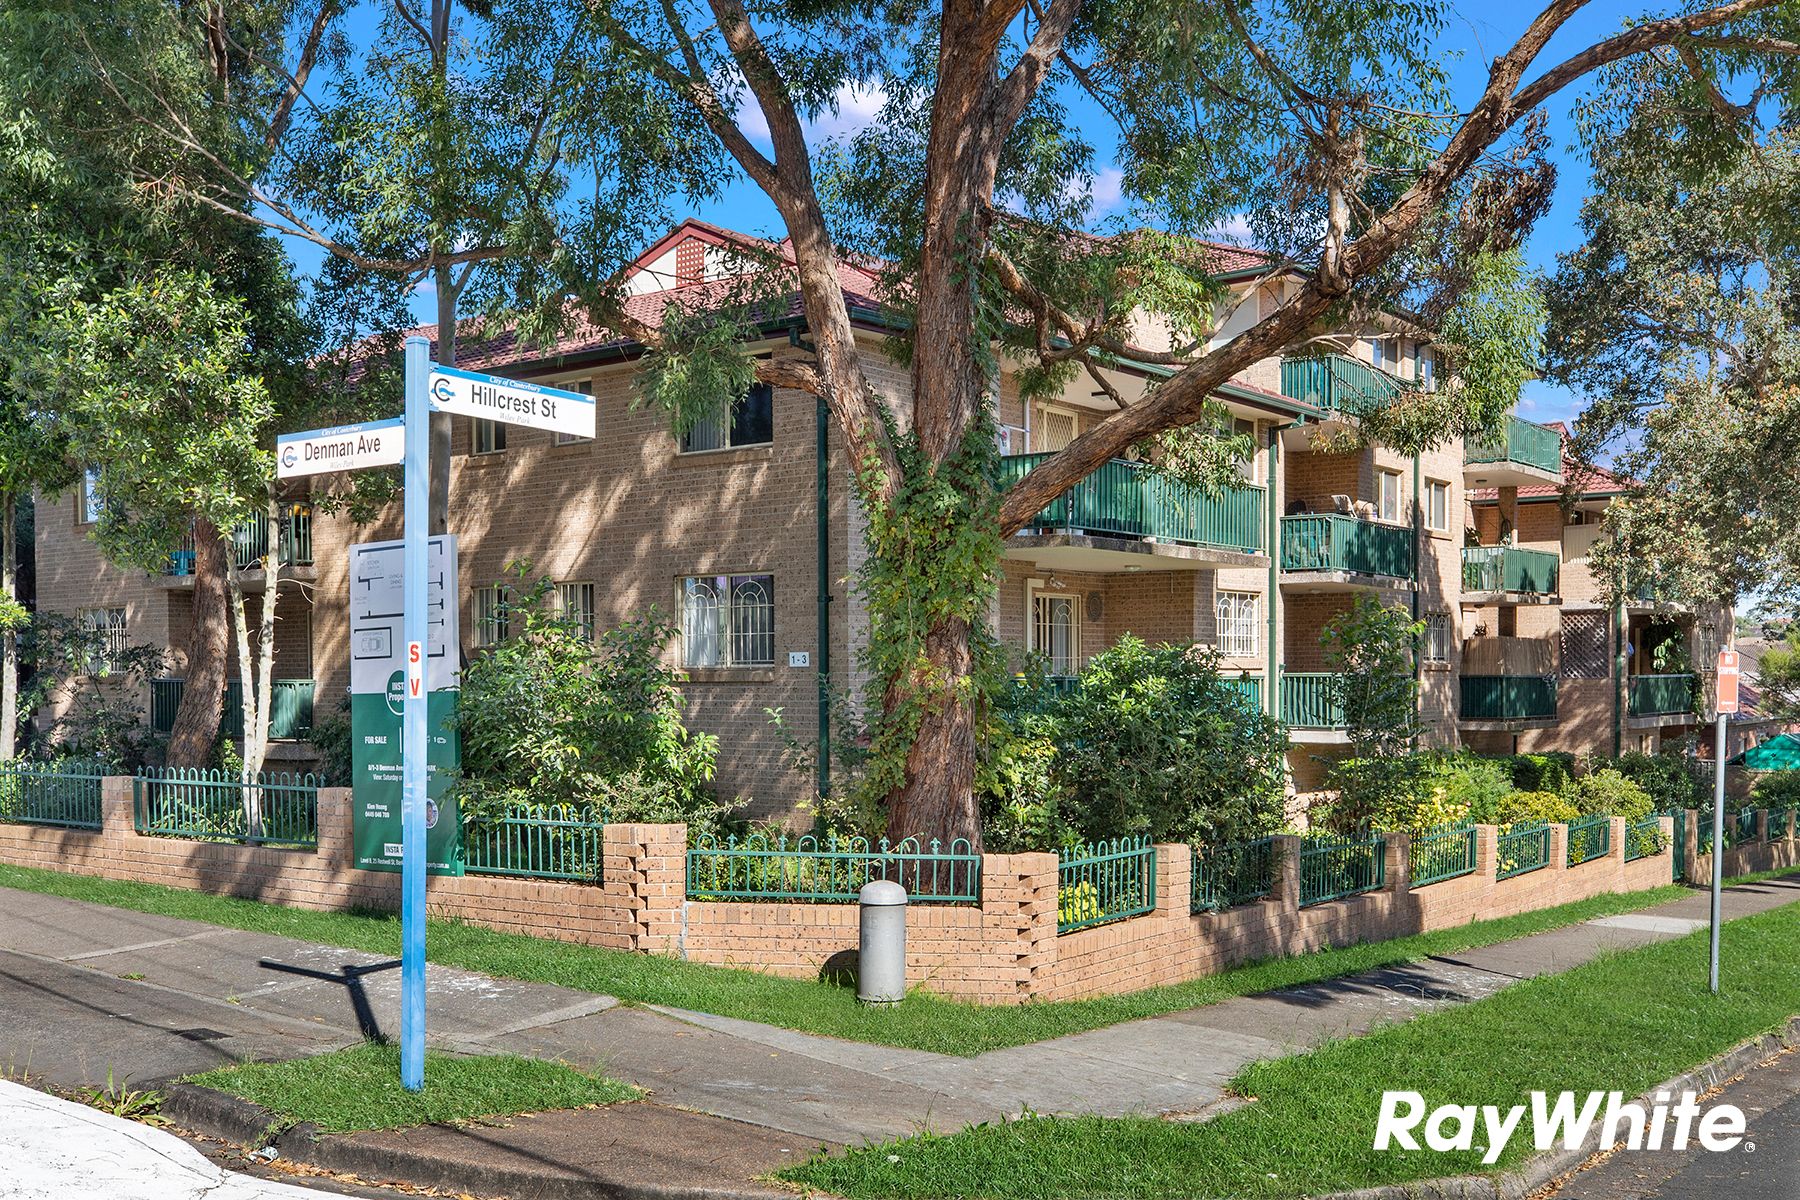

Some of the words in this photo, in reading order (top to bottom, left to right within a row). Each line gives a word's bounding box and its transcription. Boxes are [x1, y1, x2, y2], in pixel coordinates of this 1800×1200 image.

[472, 384, 536, 416] Hillcrest
[541, 398, 556, 418] St
[304, 440, 354, 461] Denman
[357, 434, 381, 455] Ave
[392, 682, 404, 690] INST
[365, 736, 374, 744] FOR
[375, 736, 387, 744] SALE
